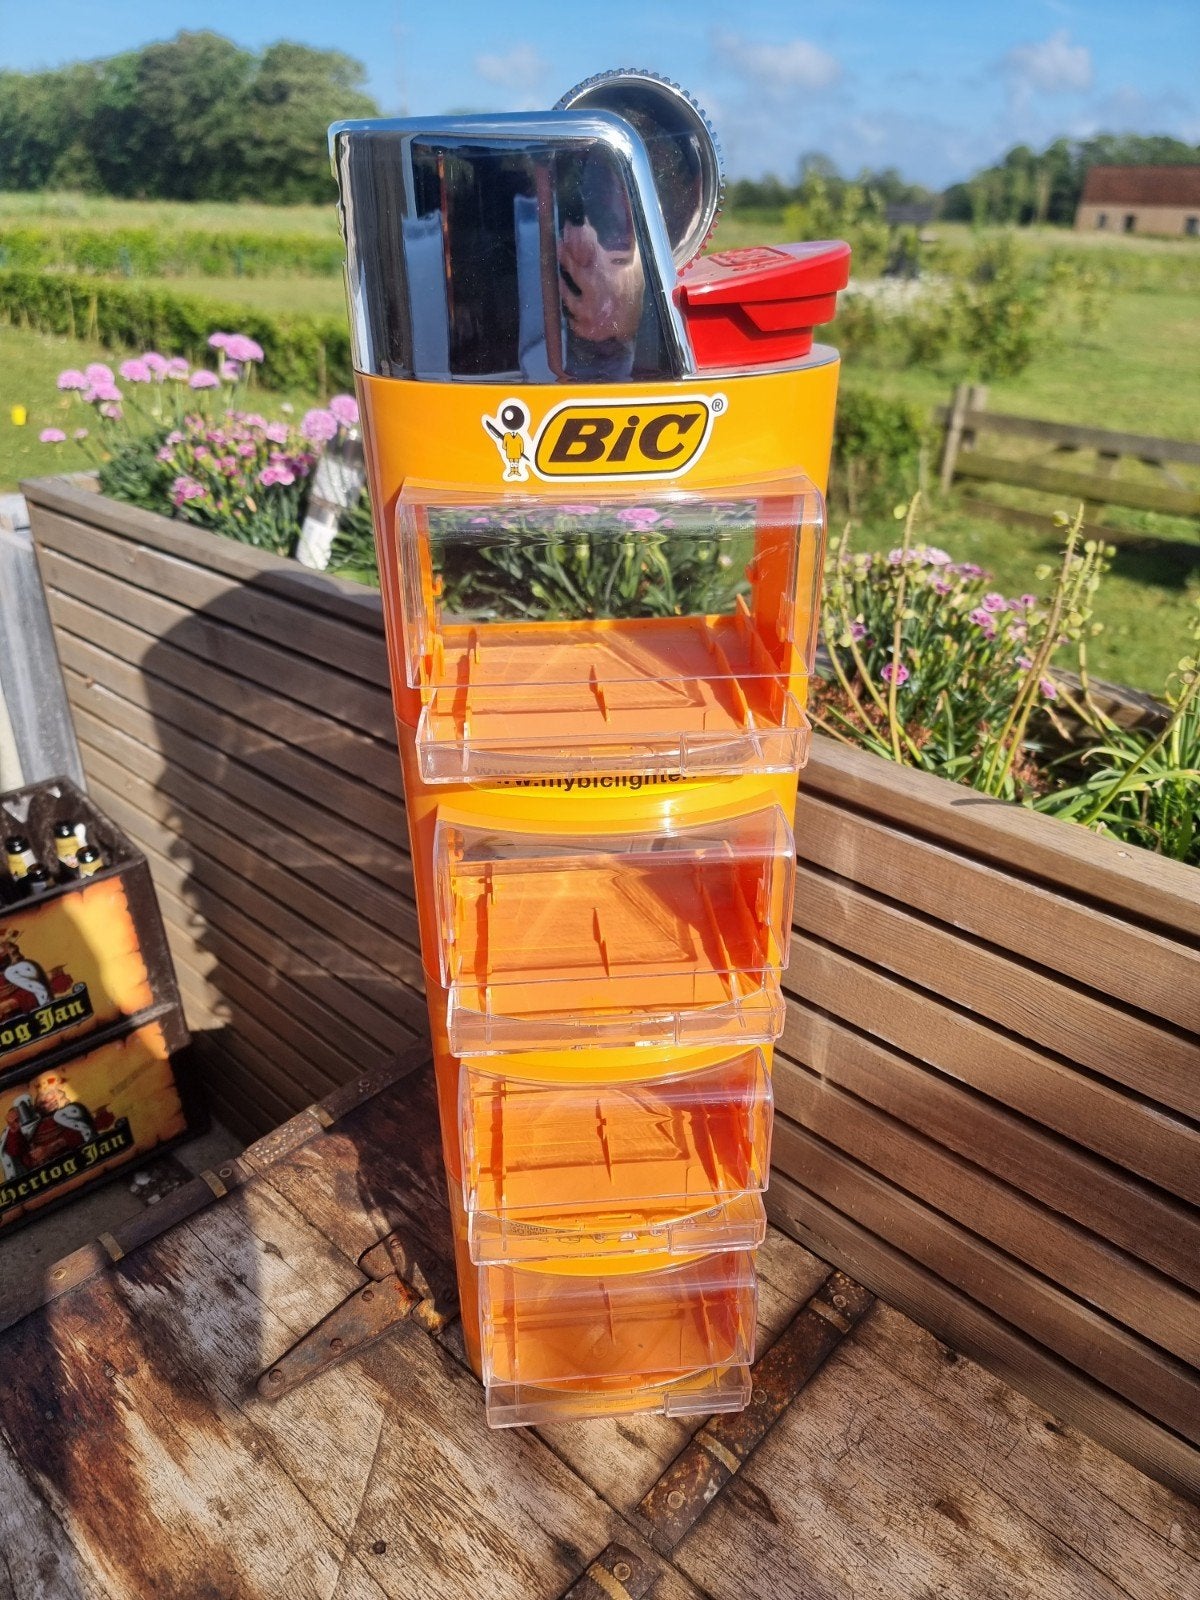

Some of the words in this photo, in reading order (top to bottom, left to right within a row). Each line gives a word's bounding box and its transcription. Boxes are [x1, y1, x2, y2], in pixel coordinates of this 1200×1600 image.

[0, 1022, 32, 1045] og
[35, 1000, 85, 1034] Jan
[81, 1134, 125, 1166] Jan
